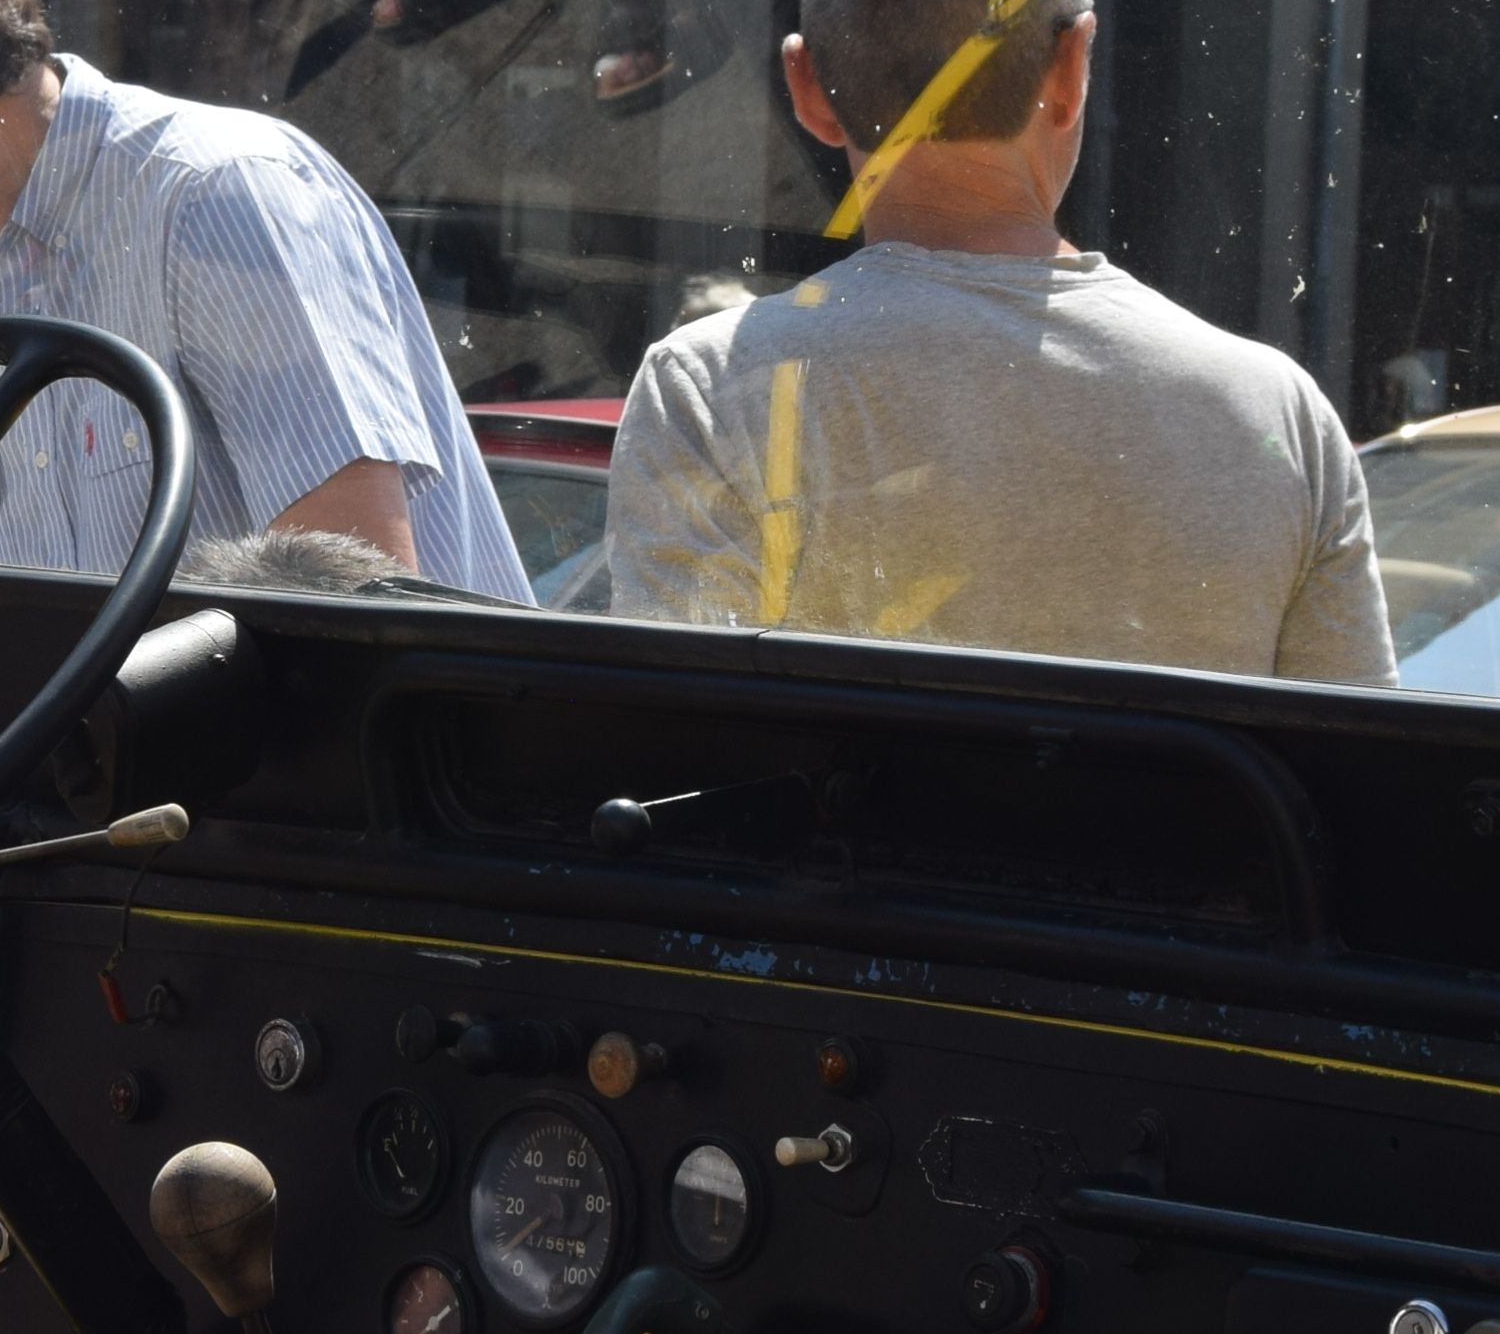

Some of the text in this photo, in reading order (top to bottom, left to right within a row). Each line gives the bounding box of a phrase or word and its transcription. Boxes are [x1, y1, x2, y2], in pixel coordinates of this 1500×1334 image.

[523, 1150, 587, 1168] 40 60
[535, 1174, 580, 1188] KILOMETER
[505, 1194, 605, 1215] 20 80
[513, 1259, 587, 1285] 0 100
